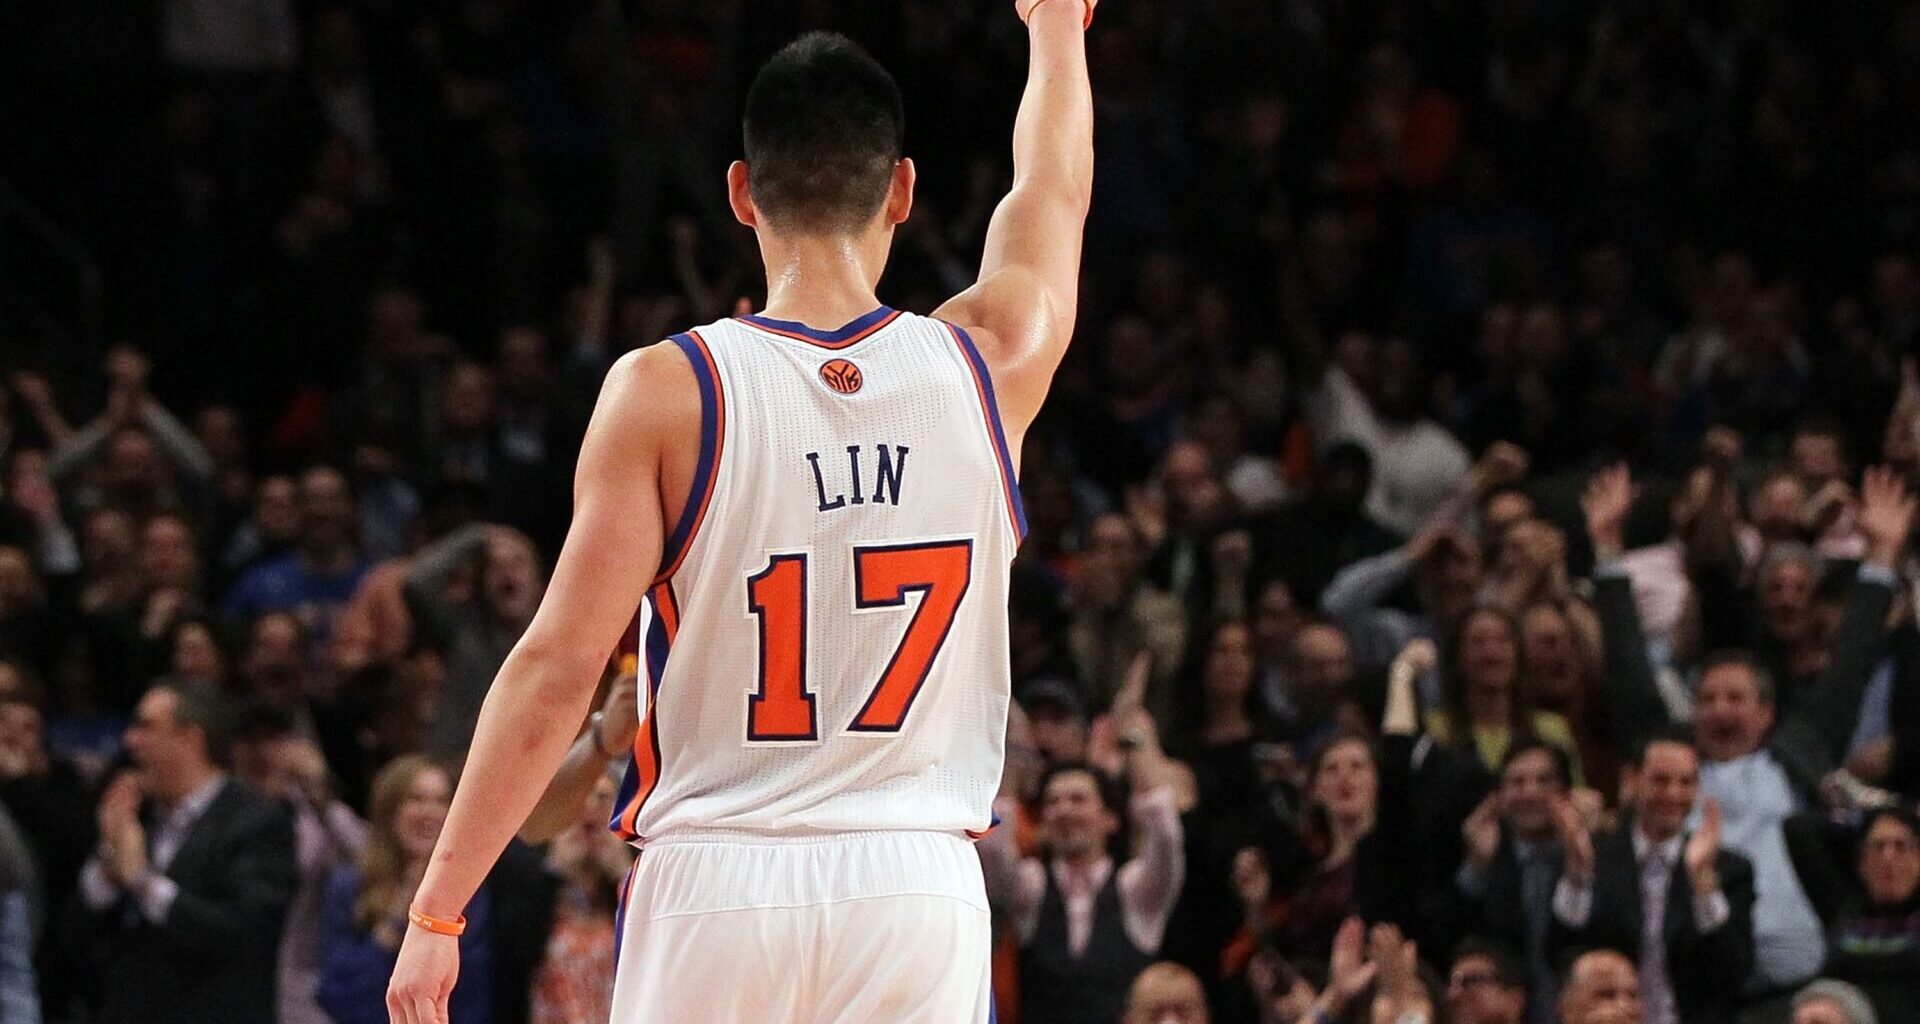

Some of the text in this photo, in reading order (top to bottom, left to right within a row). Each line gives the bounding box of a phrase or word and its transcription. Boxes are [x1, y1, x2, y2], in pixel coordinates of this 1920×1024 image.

[822, 362, 859, 392] NYK
[805, 443, 910, 512] LIN
[746, 537, 974, 742] 17
